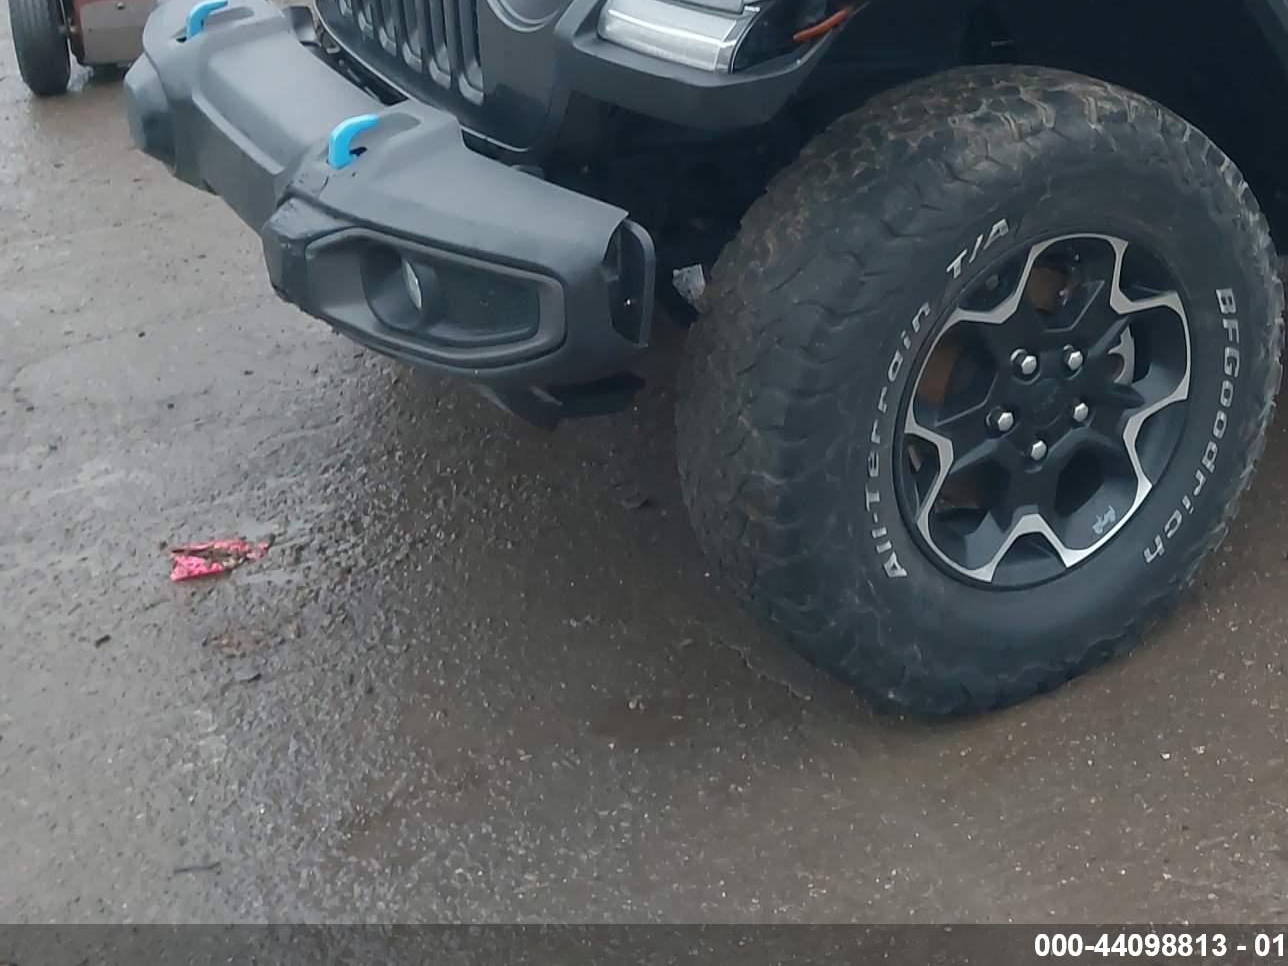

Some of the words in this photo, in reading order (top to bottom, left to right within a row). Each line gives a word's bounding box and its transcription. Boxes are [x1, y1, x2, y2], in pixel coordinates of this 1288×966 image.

[865, 300, 932, 578] All-Terrain
[945, 217, 1010, 280] T/A
[1142, 286, 1241, 564] BFGoodrich
